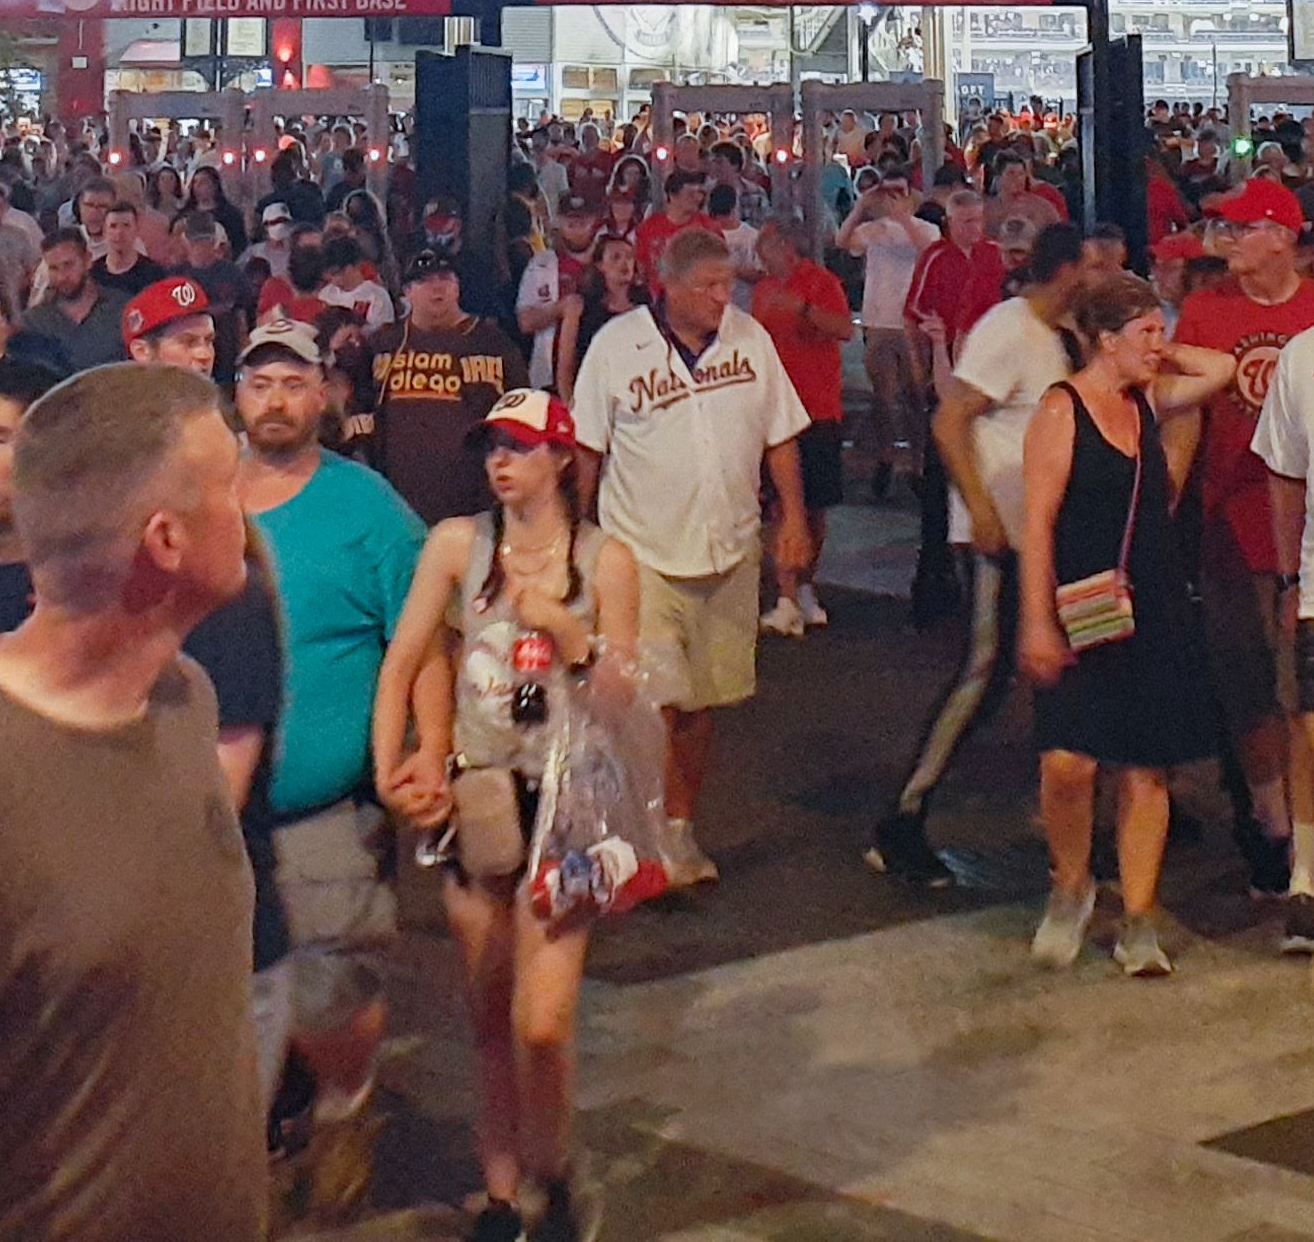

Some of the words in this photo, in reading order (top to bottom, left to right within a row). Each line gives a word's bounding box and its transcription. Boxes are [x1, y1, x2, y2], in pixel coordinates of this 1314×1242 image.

[392, 350, 453, 370] slam
[389, 370, 462, 394] diego
[628, 347, 757, 414] Natonals
